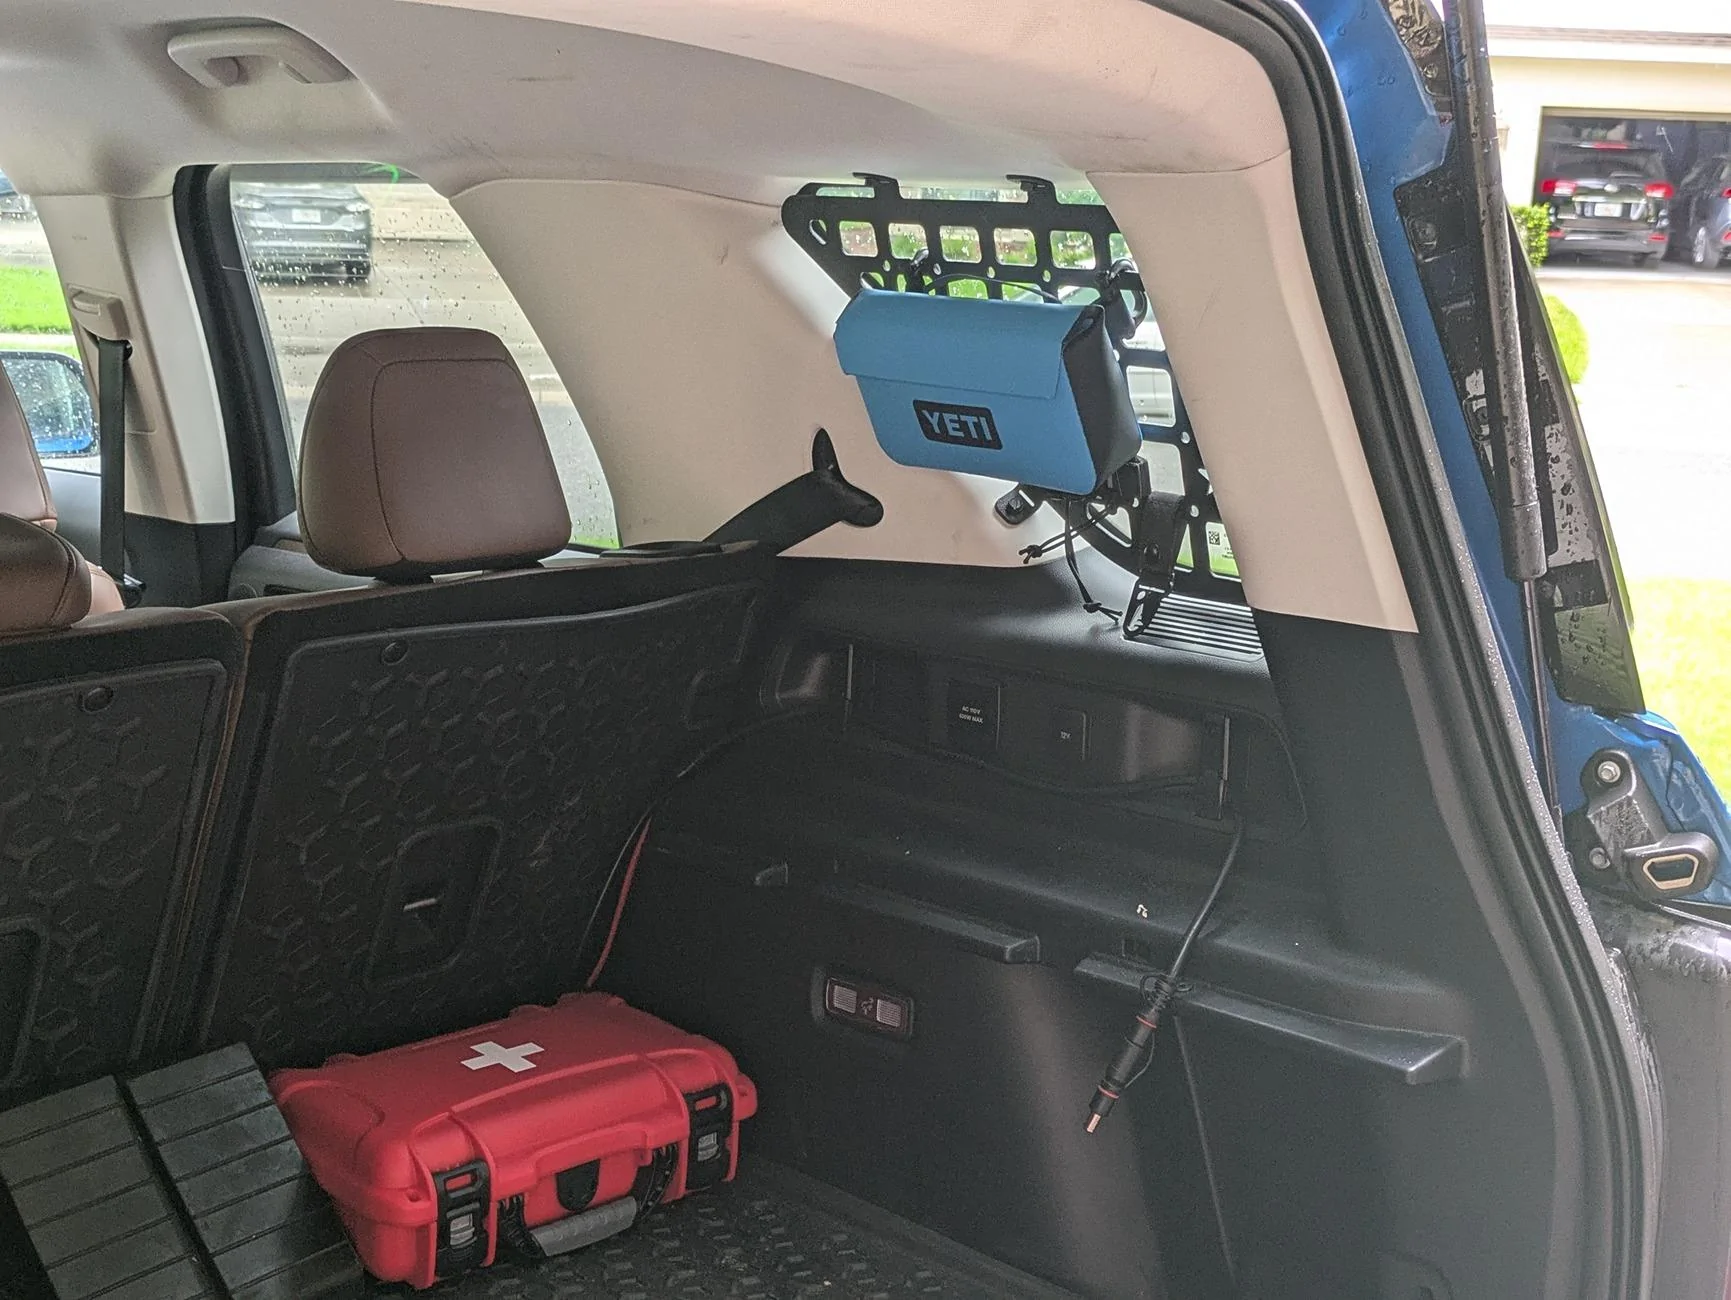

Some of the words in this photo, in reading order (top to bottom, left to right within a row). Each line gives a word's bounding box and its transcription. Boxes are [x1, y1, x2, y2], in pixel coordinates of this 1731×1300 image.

[922, 410, 992, 440] YETI
[972, 716, 984, 724] MAX
[1060, 731, 1071, 739] 12V
